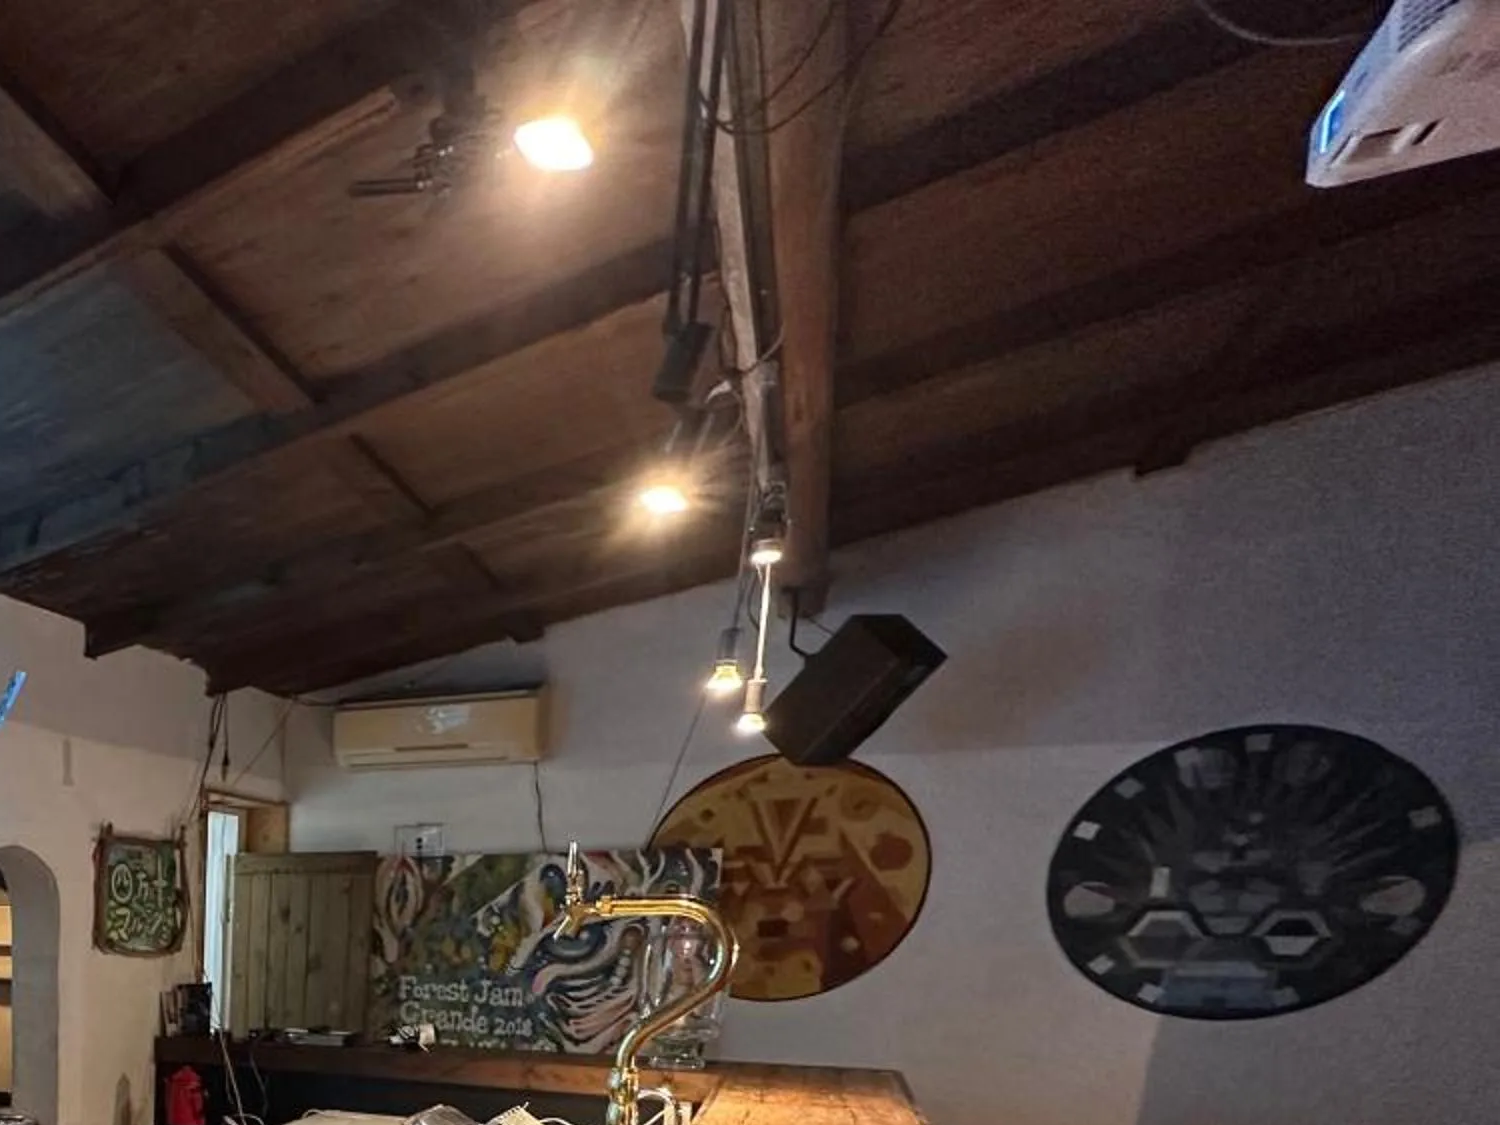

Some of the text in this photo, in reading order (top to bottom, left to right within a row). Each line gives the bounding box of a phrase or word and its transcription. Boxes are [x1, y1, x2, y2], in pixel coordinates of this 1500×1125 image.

[398, 975, 523, 1007] Forest Jam
[400, 1001, 489, 1034] Grande
